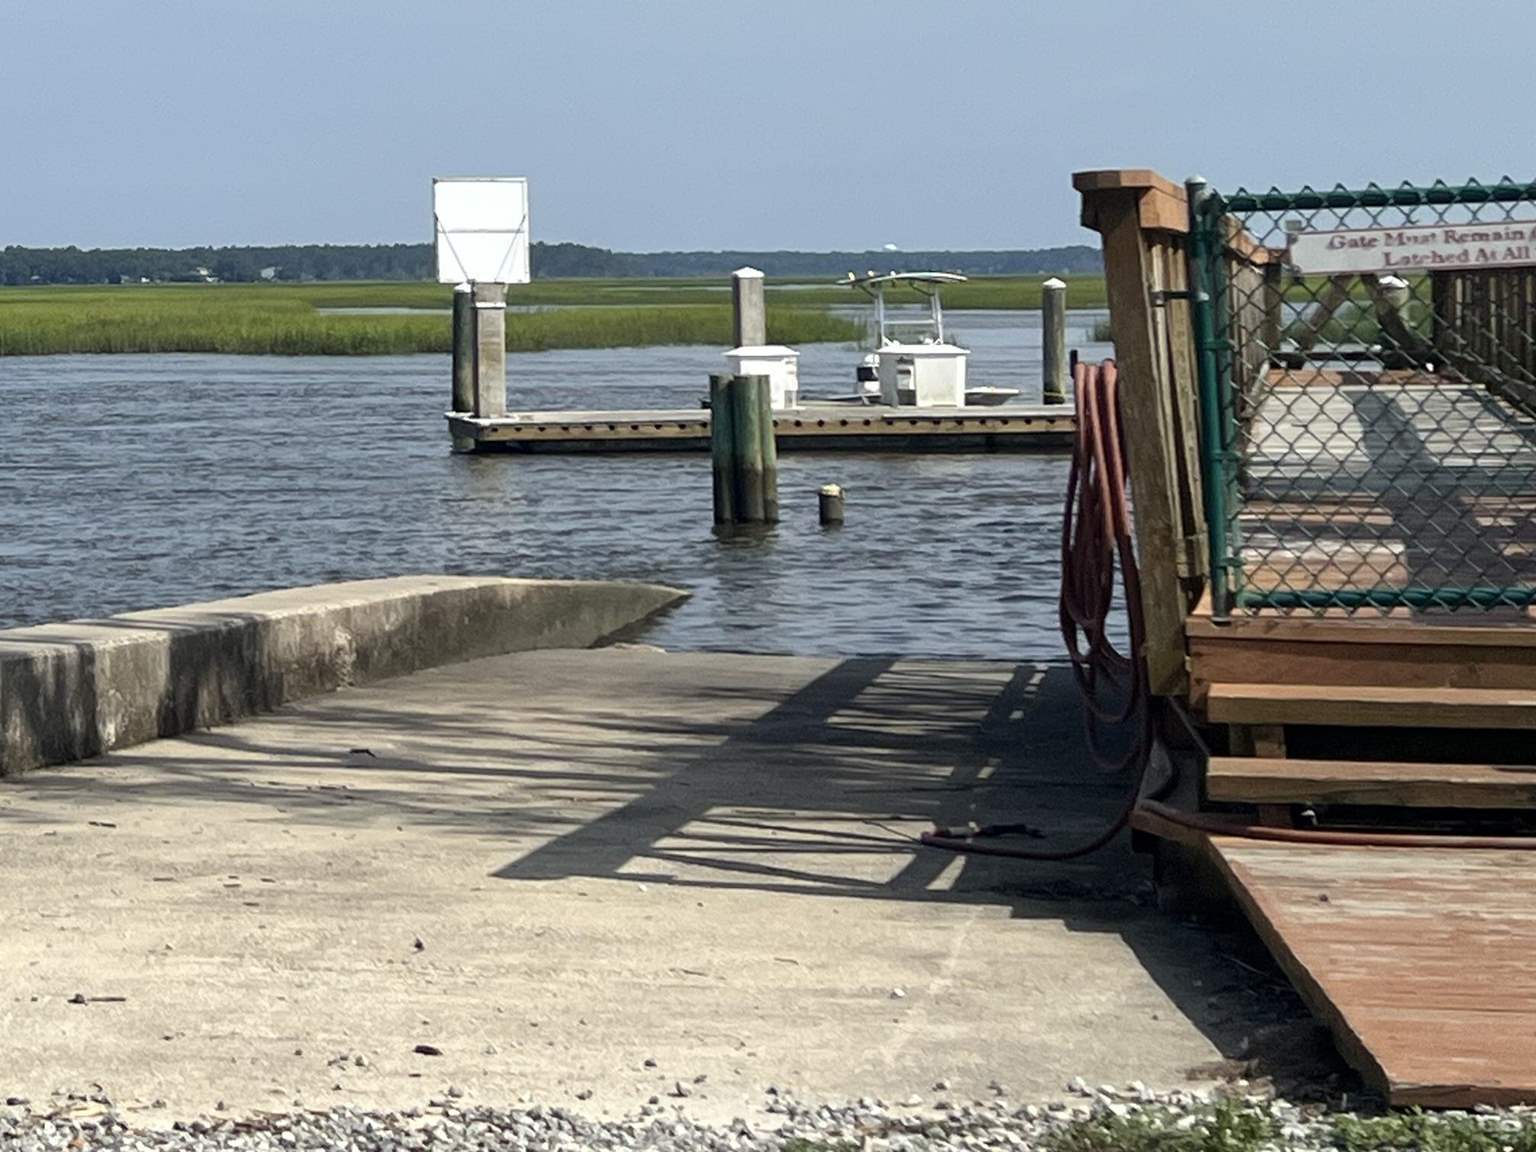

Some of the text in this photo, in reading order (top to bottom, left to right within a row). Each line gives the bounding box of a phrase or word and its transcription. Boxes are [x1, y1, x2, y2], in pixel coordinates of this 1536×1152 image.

[1327, 235, 1379, 250] Gate
[1384, 231, 1437, 247] Must
[1444, 227, 1524, 244] Remain
[1383, 246, 1531, 266] Latched At All
